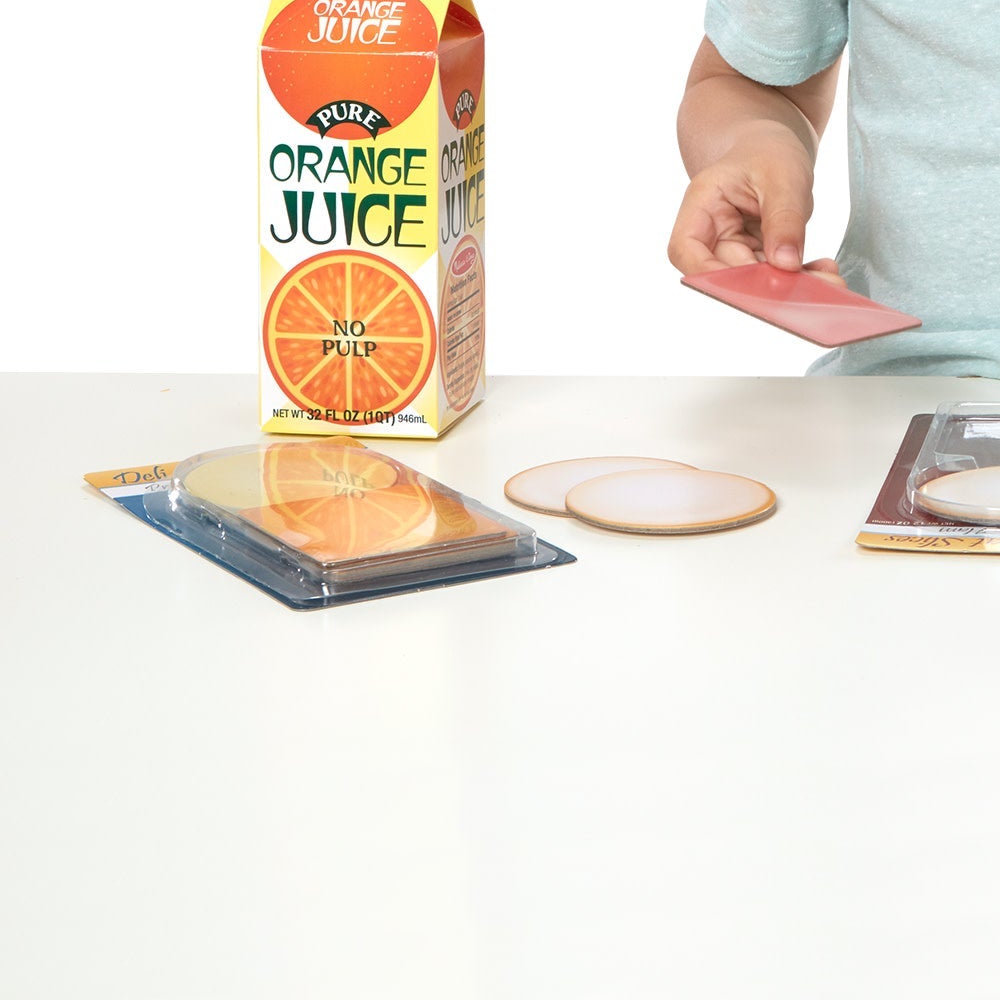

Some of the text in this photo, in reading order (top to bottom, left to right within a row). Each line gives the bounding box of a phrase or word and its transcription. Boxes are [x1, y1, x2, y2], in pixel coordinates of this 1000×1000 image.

[307, 16, 402, 45] JUICE
[316, 103, 381, 130] PURE
[455, 92, 474, 118] PURE
[269, 143, 427, 186] ORANGE
[441, 126, 485, 183] ORANGE
[270, 190, 427, 248] JUICE
[441, 170, 485, 245] JUICE
[332, 320, 366, 337] NO
[322, 340, 377, 357] PULP
[272, 408, 428, 426] NET WT 32 FL OZ (1QT) 946mL
[113, 466, 167, 484] Deli
[884, 536, 964, 548] Slices
